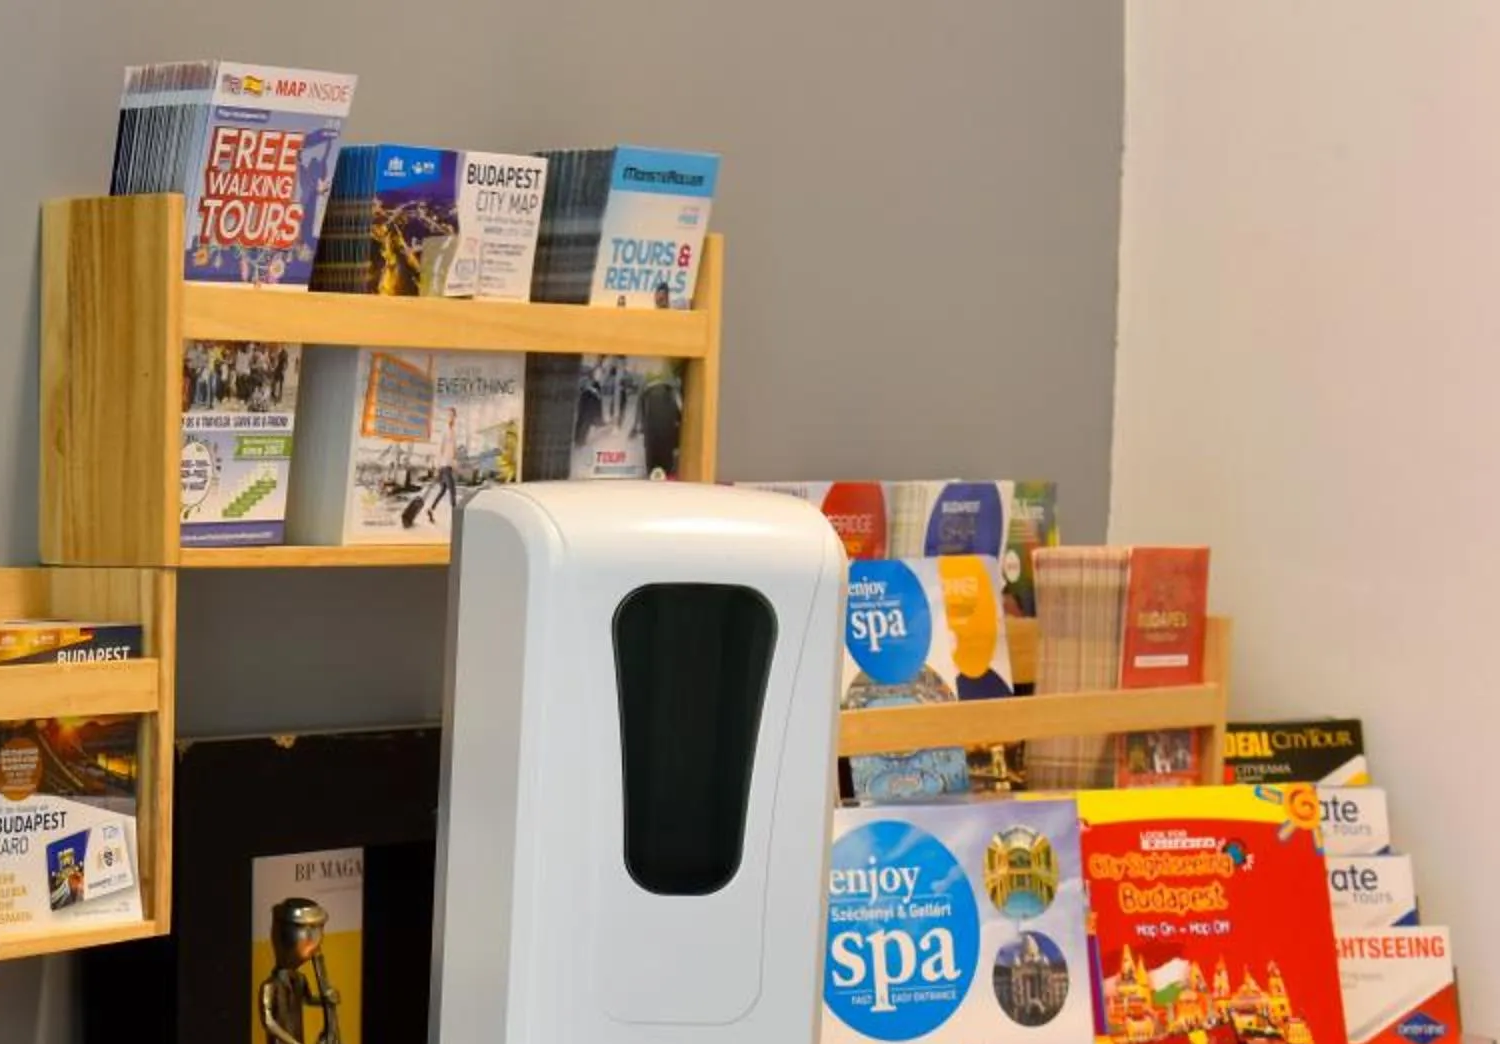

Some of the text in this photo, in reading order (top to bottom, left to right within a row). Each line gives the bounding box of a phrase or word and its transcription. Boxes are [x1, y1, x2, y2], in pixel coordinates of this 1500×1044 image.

[275, 79, 352, 102] MAP INSIDE
[211, 126, 305, 173] FREE
[207, 171, 294, 199] WALKING
[466, 163, 543, 190] BUDAPEST
[475, 189, 539, 215] CITY MAP
[202, 198, 304, 243] TOURS
[611, 237, 691, 268] TOURS &
[604, 266, 688, 294] RENTALS
[436, 376, 516, 396] EVERYTHING
[849, 576, 887, 600] enjoy
[850, 607, 906, 653] spa
[57, 646, 131, 665] BUDAPEST
[294, 862, 316, 882] BP
[828, 855, 922, 905] enjoy
[1118, 880, 1229, 917] Budapest
[830, 926, 962, 1013] spa
